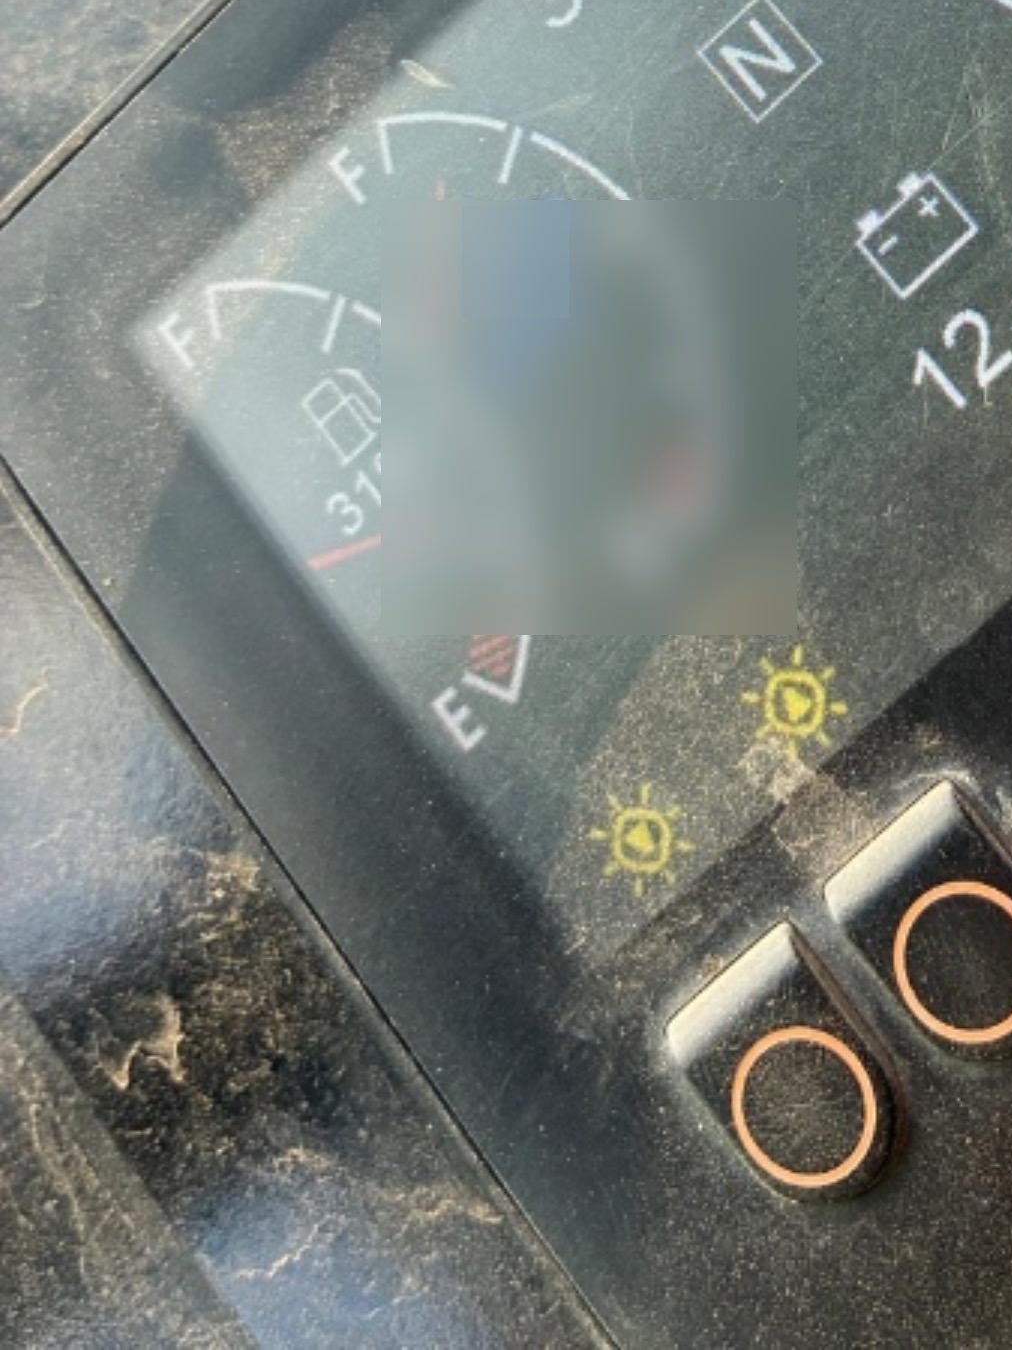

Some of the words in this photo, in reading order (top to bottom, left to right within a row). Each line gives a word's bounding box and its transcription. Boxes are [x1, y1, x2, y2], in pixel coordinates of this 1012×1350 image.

[718, 17, 796, 103] N
[327, 145, 368, 206] F
[156, 310, 203, 370] F
[325, 451, 381, 536] 31
[430, 684, 487, 753] E
